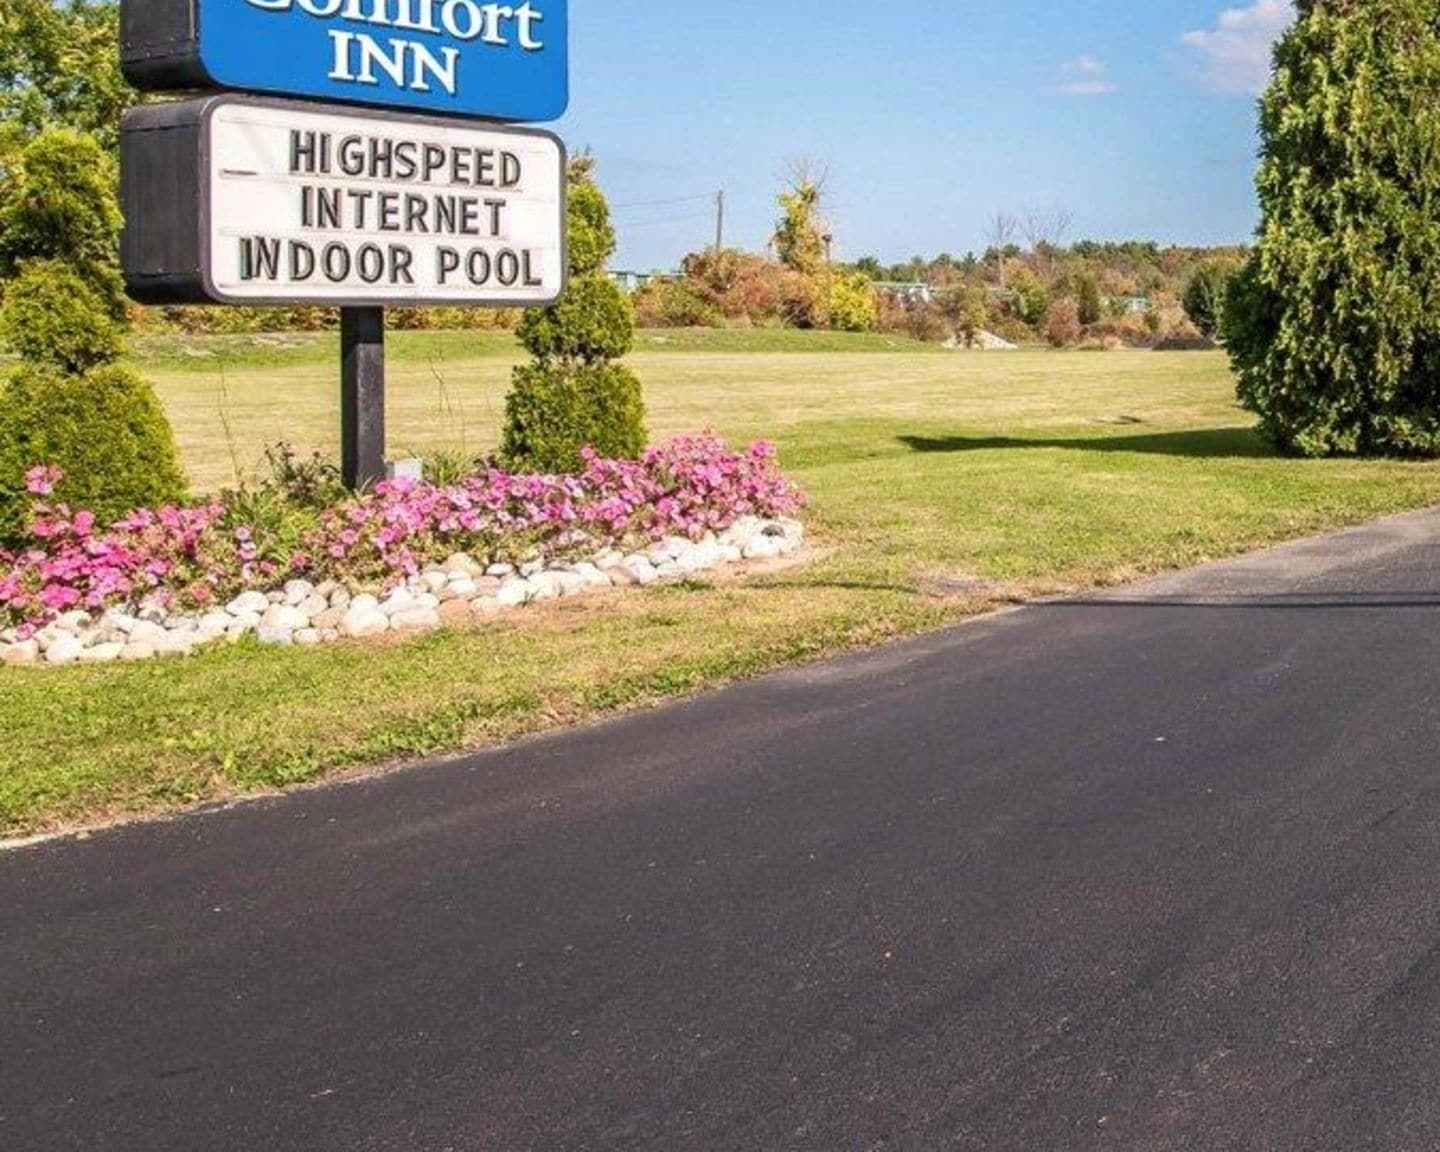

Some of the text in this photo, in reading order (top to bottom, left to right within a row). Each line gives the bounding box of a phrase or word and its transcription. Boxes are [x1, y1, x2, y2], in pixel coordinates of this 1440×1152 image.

[328, 29, 459, 95] INN
[289, 129, 521, 188] HIGHSPEED
[301, 186, 507, 236] INTERNET
[240, 236, 543, 286] INDOOR POOL
